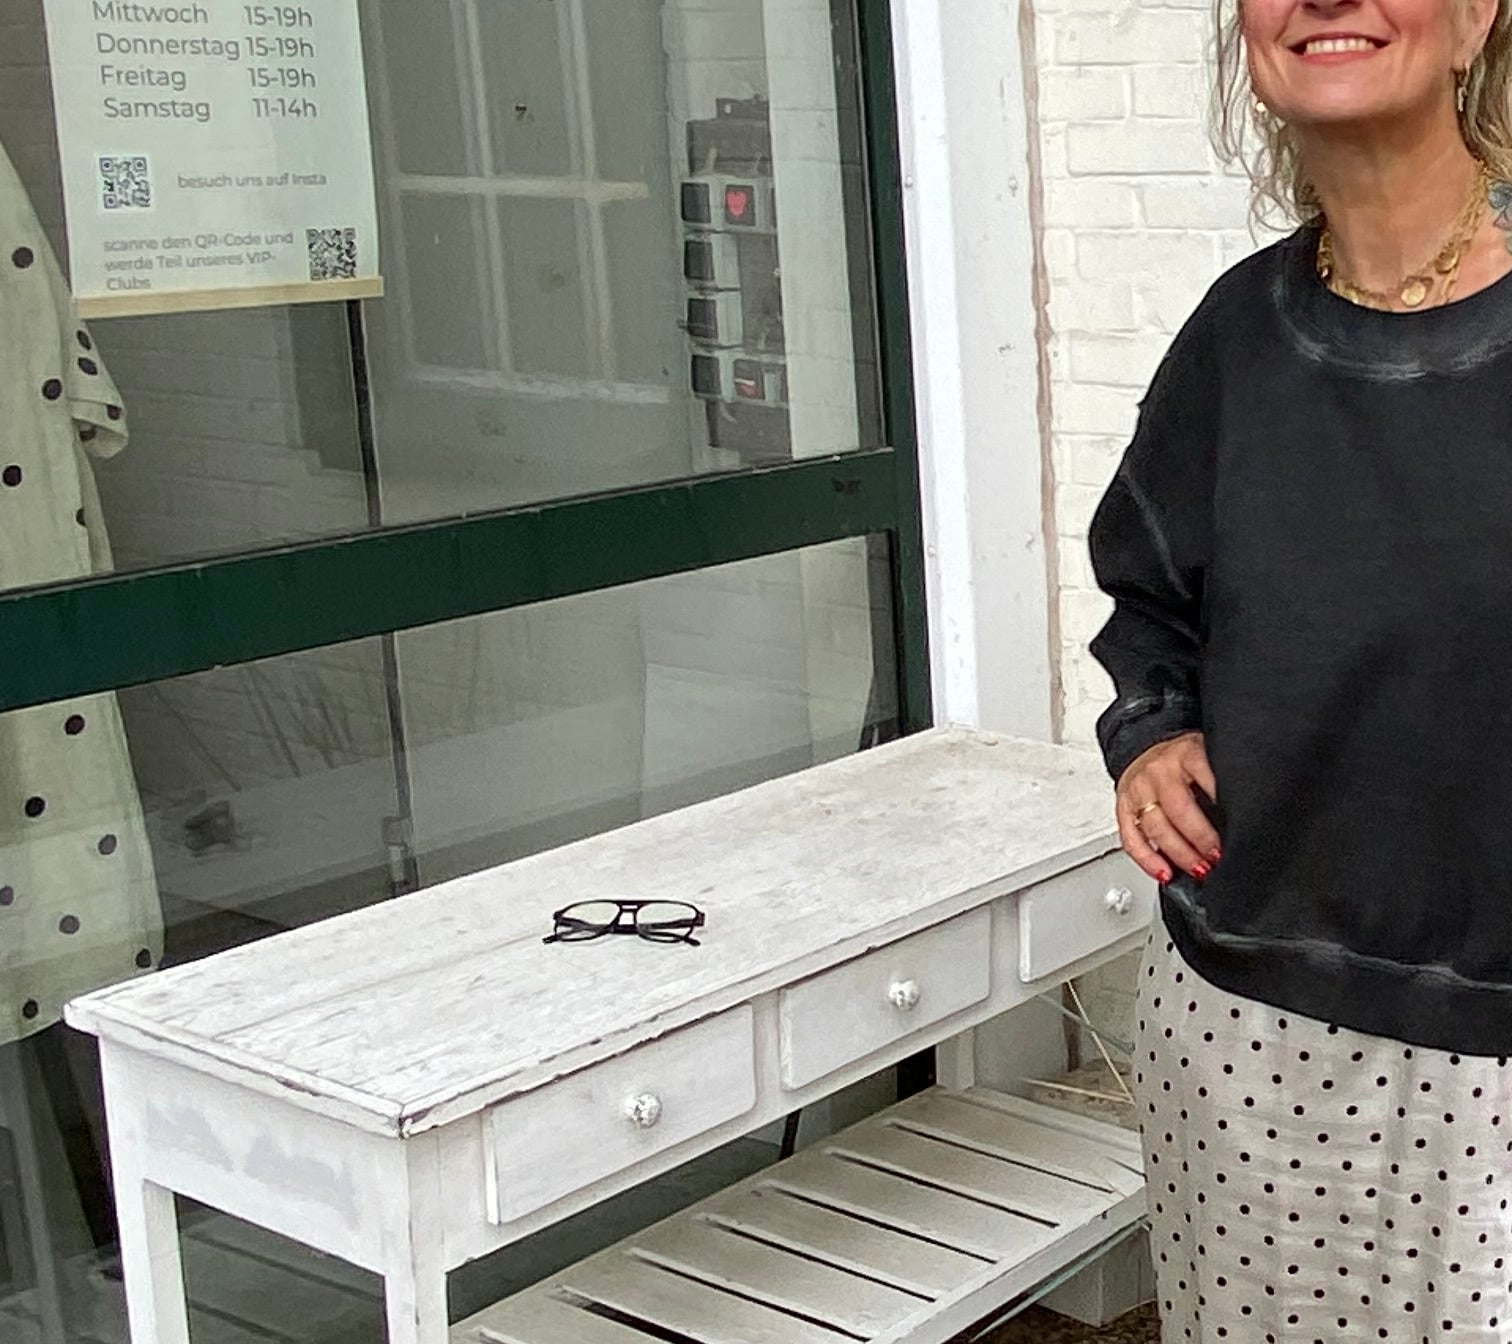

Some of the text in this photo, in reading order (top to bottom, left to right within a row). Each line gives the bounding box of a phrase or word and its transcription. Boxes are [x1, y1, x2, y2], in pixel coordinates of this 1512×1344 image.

[92, 0, 312, 27] Mittwoch 15-19h
[97, 32, 314, 61] Donnerstag 15-19h
[100, 64, 316, 91] Freitag 15-19h
[104, 97, 317, 122] Samstag 11-14h
[177, 173, 232, 189] besuch
[236, 176, 262, 188] uns
[266, 173, 288, 187] auf
[162, 236, 191, 249] den
[265, 232, 293, 245] und
[156, 255, 182, 269] Teil
